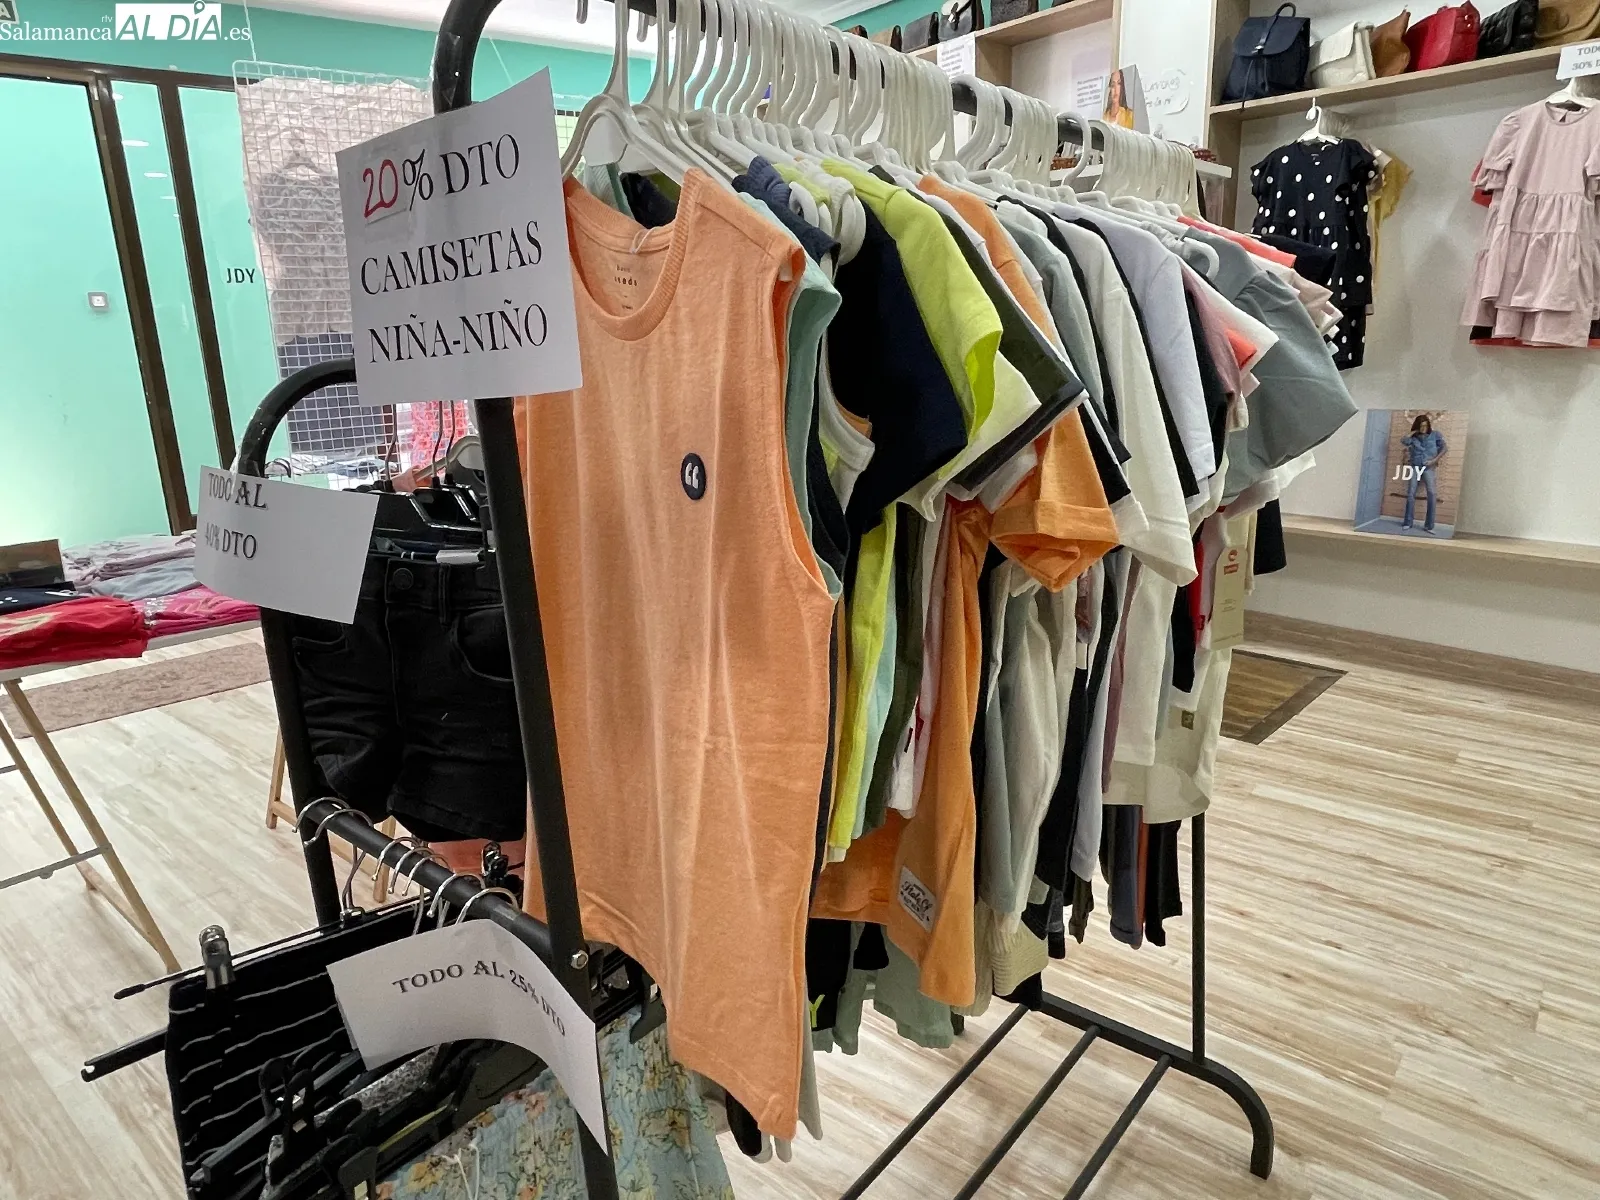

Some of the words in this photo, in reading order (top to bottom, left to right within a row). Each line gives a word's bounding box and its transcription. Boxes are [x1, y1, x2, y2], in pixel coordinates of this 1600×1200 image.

[362, 148, 434, 219] 20%
[439, 133, 520, 196] DTO
[226, 267, 255, 284] JDY
[360, 220, 543, 296] CAMISETAS
[367, 298, 548, 364] NIÑA-NIÑO
[208, 472, 232, 502] TODO
[235, 480, 268, 509] AL
[1391, 464, 1427, 482] JDY
[222, 528, 257, 560] DTO
[392, 964, 464, 994] TODO
[473, 960, 505, 979] AL
[509, 969, 540, 1004] 25%
[540, 995, 566, 1036] DTO
